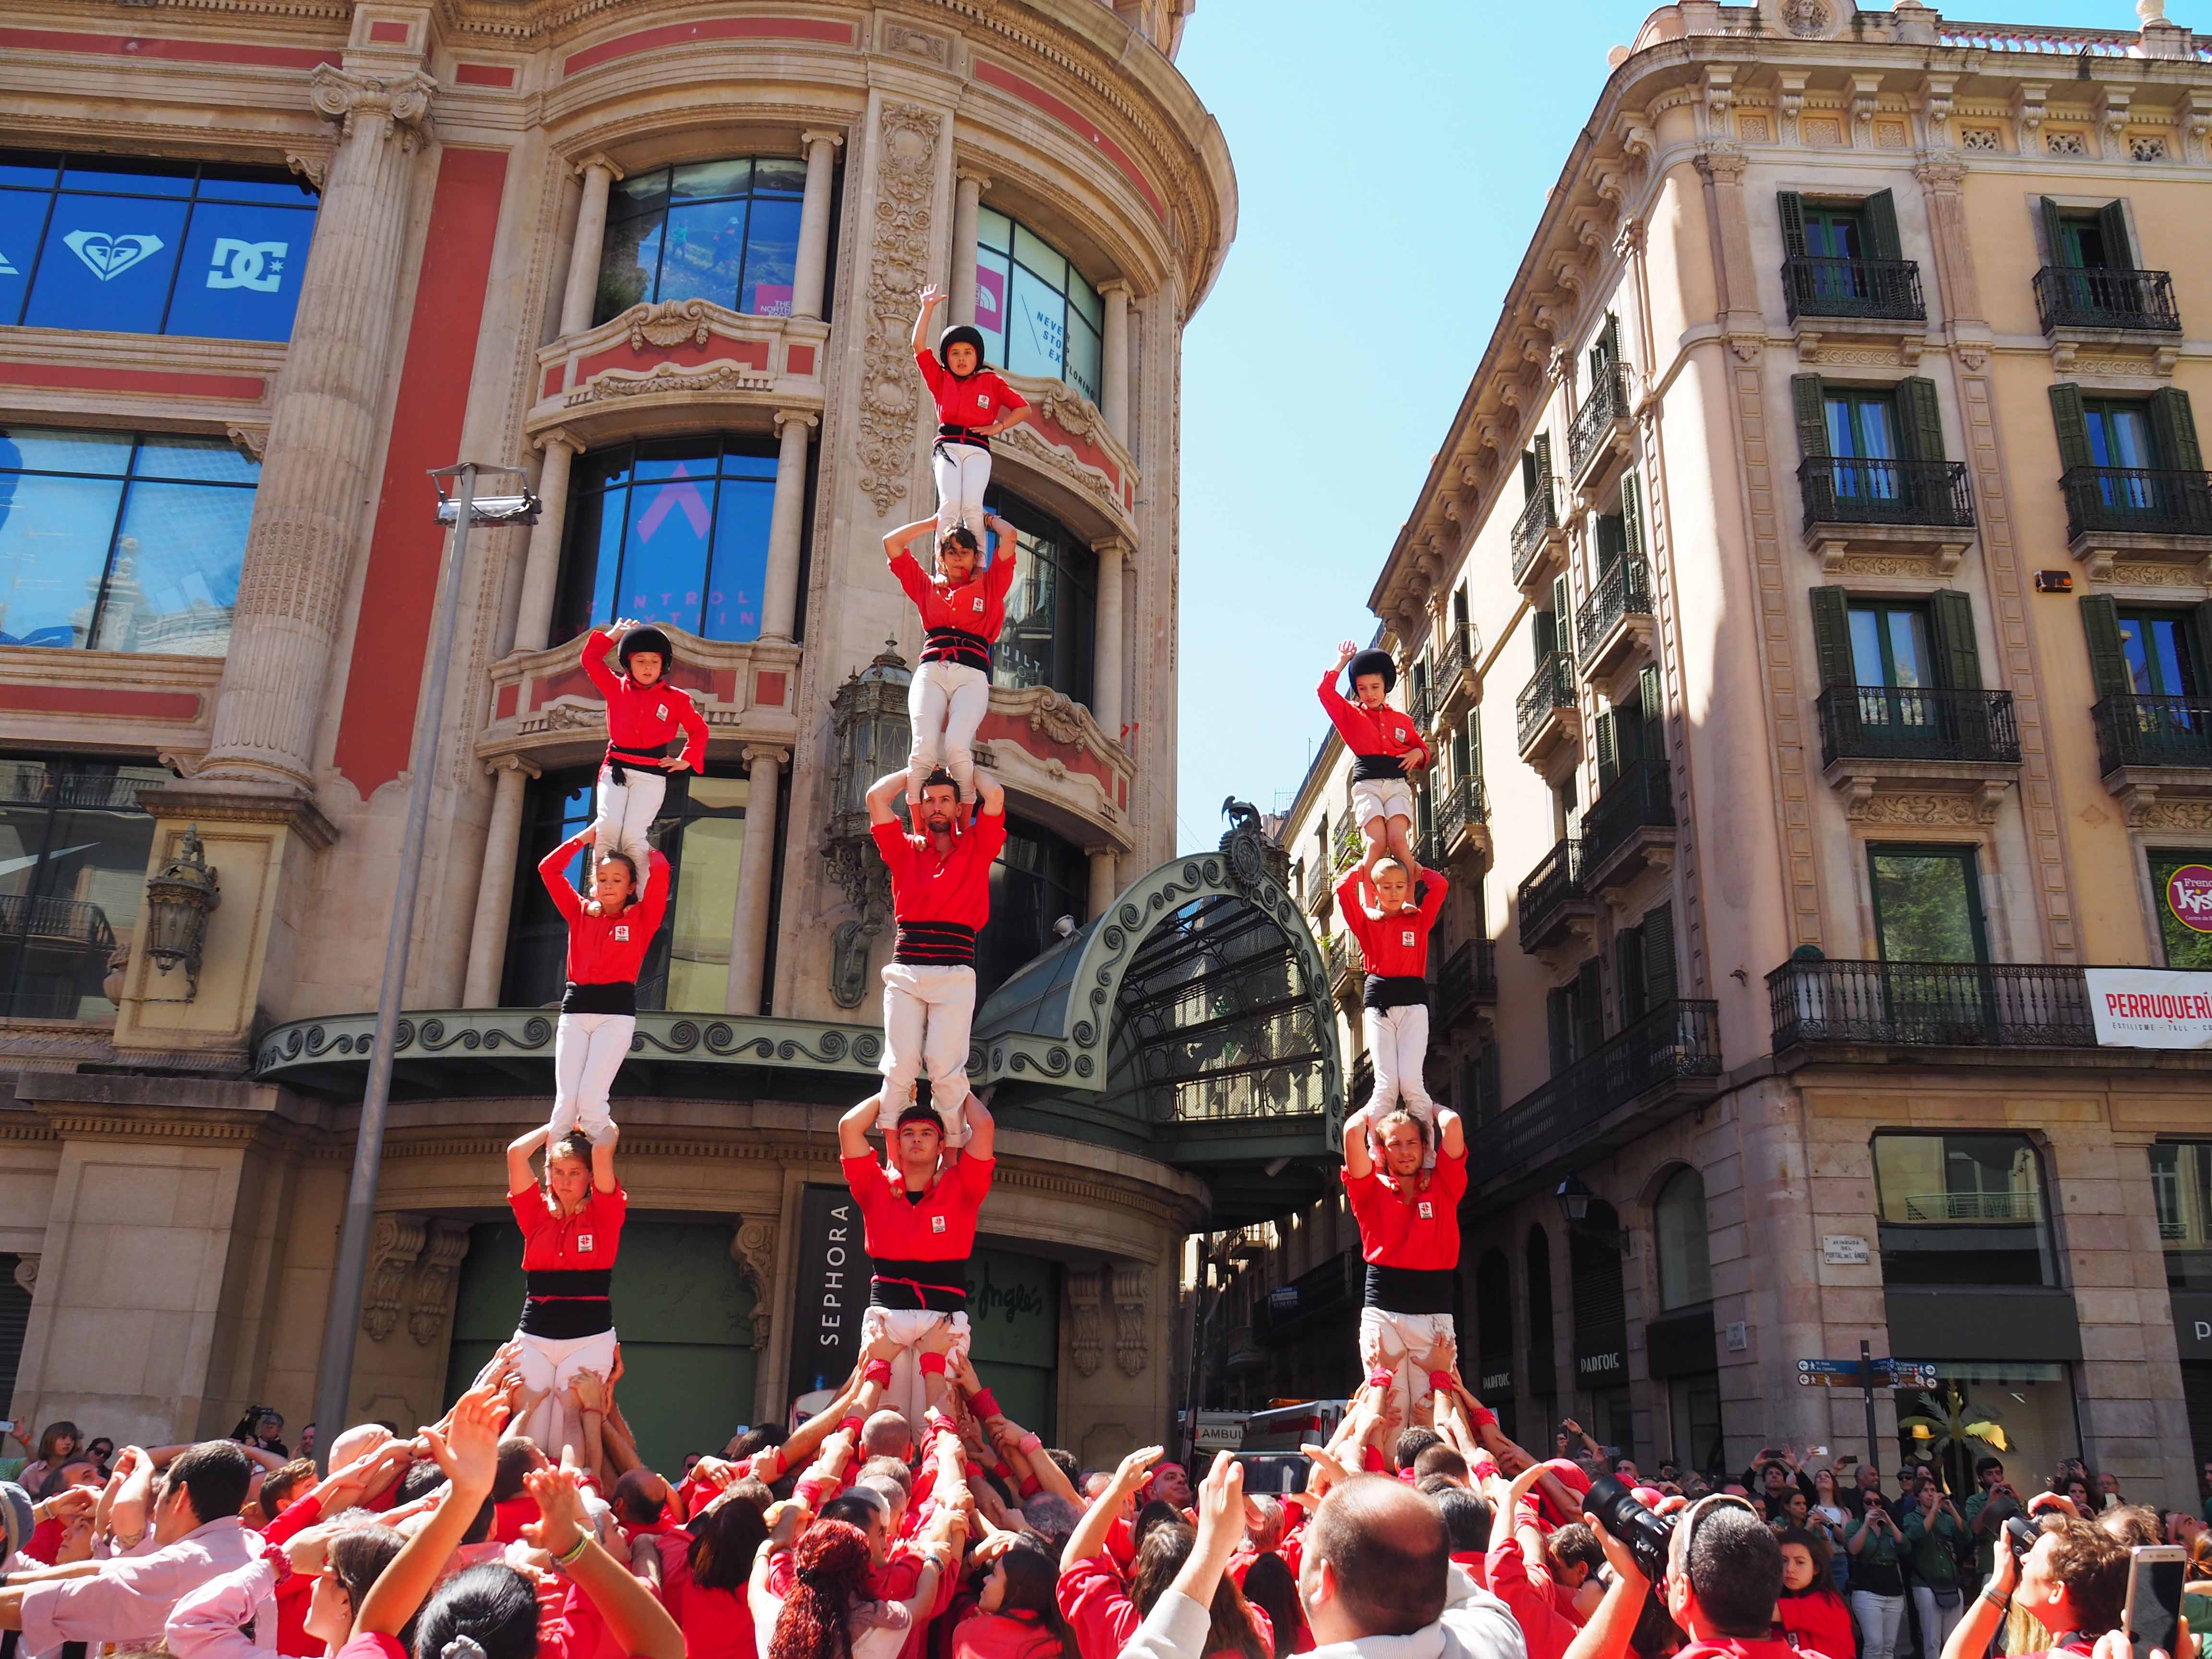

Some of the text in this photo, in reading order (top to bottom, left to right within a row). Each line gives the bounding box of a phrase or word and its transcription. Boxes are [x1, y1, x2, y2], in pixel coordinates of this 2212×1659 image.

[1005, 659, 1026, 677] TO
[2105, 991, 2212, 1023] PERRUQUERÍ
[2112, 1022, 2154, 1031] ESTILISME
[820, 1205, 849, 1346] SEPHORA
[1580, 1352, 1619, 1373] PARFOIS
[1483, 1372, 1510, 1390] PARFOIS
